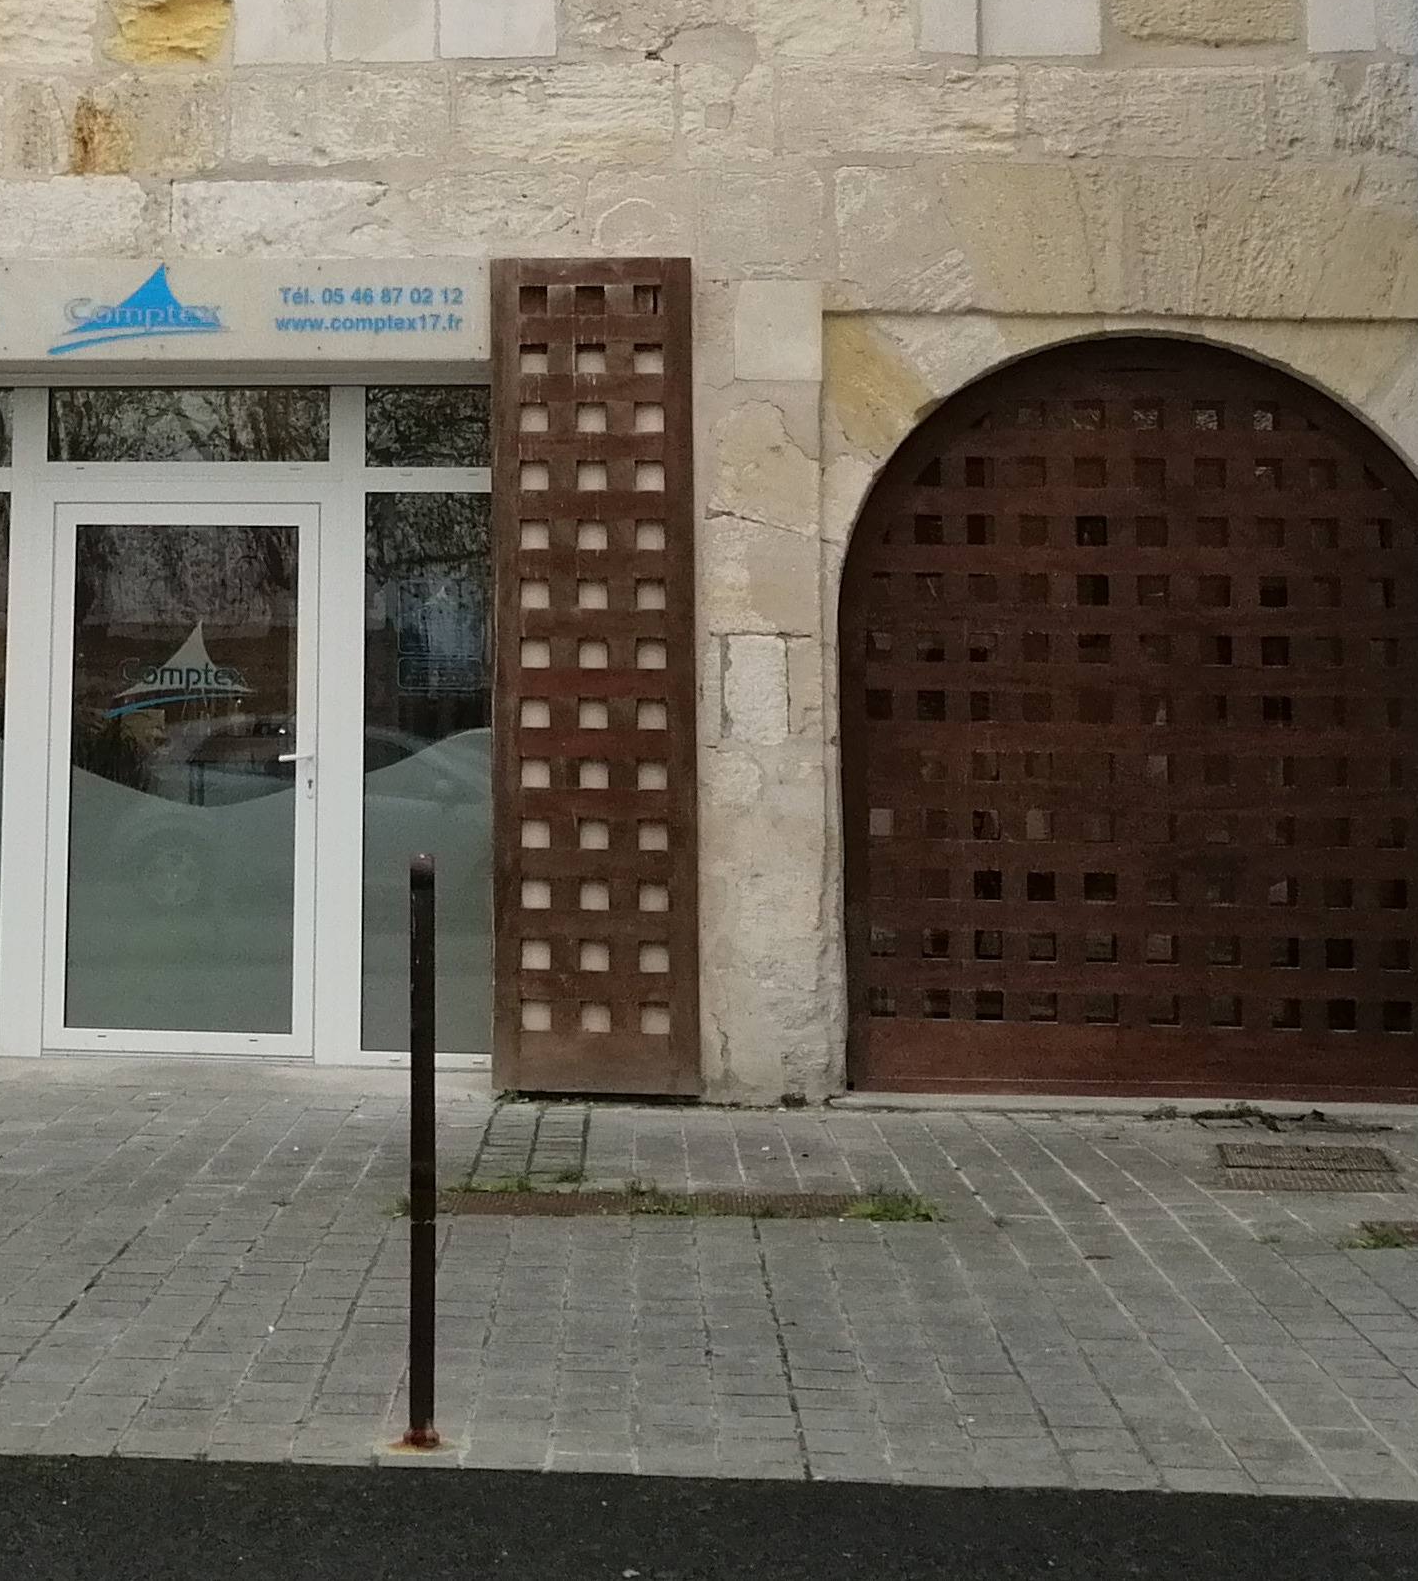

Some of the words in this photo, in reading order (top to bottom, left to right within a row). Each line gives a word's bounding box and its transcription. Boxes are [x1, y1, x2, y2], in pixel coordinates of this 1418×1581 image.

[279, 286, 315, 305] Tél.
[322, 286, 344, 305] 05
[350, 286, 375, 305] 46
[380, 286, 403, 305] 87
[410, 286, 434, 305] 02
[440, 286, 463, 305] 12
[64, 297, 222, 333] Comptex
[275, 313, 463, 333] www.comptex17.fr
[119, 656, 248, 693] Comptex
